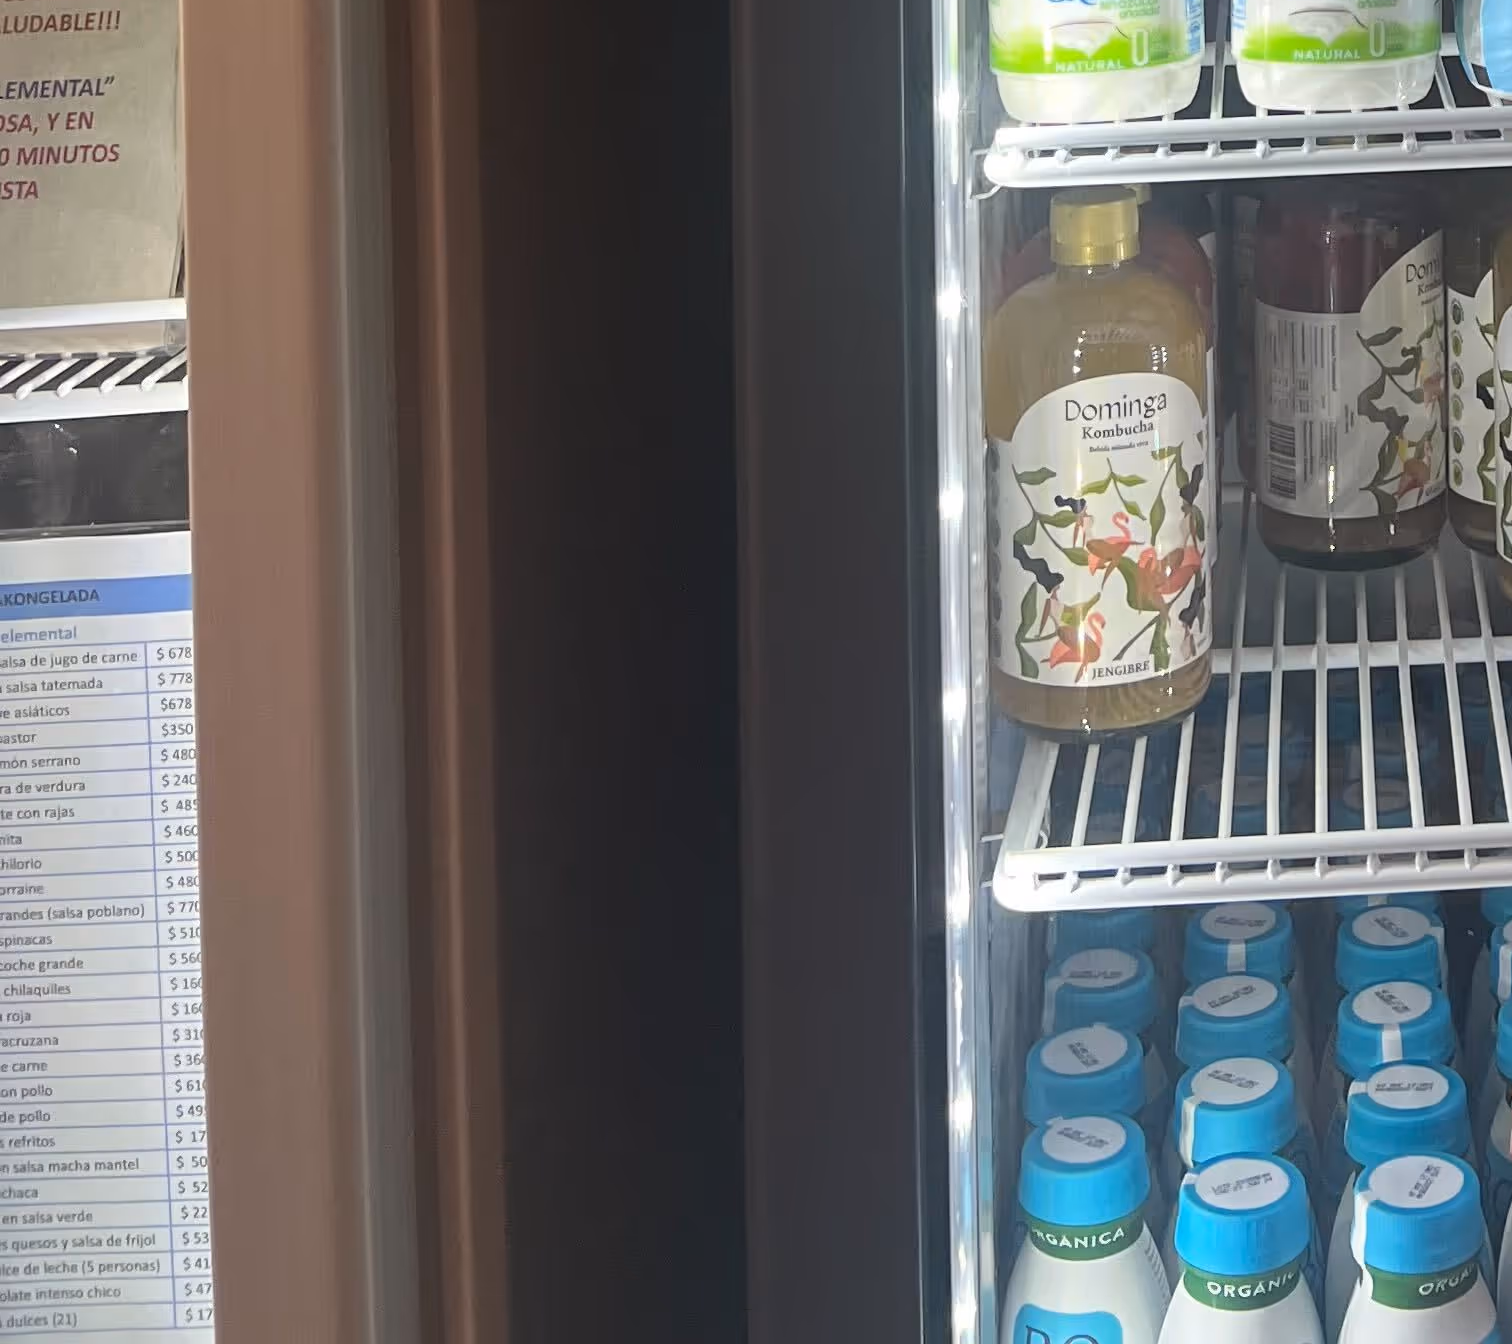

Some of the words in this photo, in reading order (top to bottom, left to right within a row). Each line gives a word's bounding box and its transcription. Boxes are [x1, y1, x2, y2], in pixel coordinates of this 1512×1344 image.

[1293, 48, 1361, 61] NATURAL
[47, 112, 61, 132] Y
[65, 111, 94, 130] EN
[16, 143, 120, 166] MINUTOS
[1064, 392, 1168, 421] Dominga
[1081, 419, 1155, 440] Kombucha
[0, 588, 101, 608] KONGELADA
[1, 626, 78, 644] elemental
[30, 654, 47, 667] de
[51, 655, 79, 669] jugo
[82, 651, 99, 664] de
[168, 646, 193, 659] 678
[169, 672, 193, 685] 778
[1091, 660, 1151, 681] JENGIBRE
[6, 679, 38, 693] salsa
[41, 676, 104, 692] tatemada
[14, 703, 71, 720] asiáticos
[160, 697, 193, 712] $678
[162, 722, 194, 738] $350
[31, 754, 82, 769] serrano
[15, 780, 32, 794] de
[35, 778, 86, 793] verdura
[17, 809, 41, 821] con
[44, 806, 75, 821] rajas
[48, 906, 83, 922] (salsa
[87, 903, 145, 920] poblano)
[38, 956, 84, 973] grande
[3, 981, 72, 998] chilaquiles
[6, 1010, 32, 1024] roja
[21, 1084, 54, 1099] pollo
[19, 1109, 51, 1124] pollo
[8, 1133, 56, 1149] refritos
[13, 1161, 44, 1174] salsa
[48, 1158, 90, 1172] macha
[94, 1156, 140, 1171] mantel
[2, 1214, 18, 1226] en
[22, 1211, 54, 1226] salsa
[56, 1209, 93, 1224] verde
[12, 1238, 58, 1253] quesos
[61, 1239, 69, 1251] y
[71, 1235, 103, 1249] salsa
[106, 1233, 122, 1247] de
[125, 1232, 156, 1248] frijol
[23, 1261, 40, 1276] de
[43, 1259, 79, 1275] leche
[81, 1259, 95, 1275] (5
[98, 1258, 161, 1276] personas)
[35, 1286, 84, 1301] intenso
[87, 1285, 122, 1299] chico
[6, 1313, 49, 1329] dulces
[52, 1311, 78, 1328] (21)
